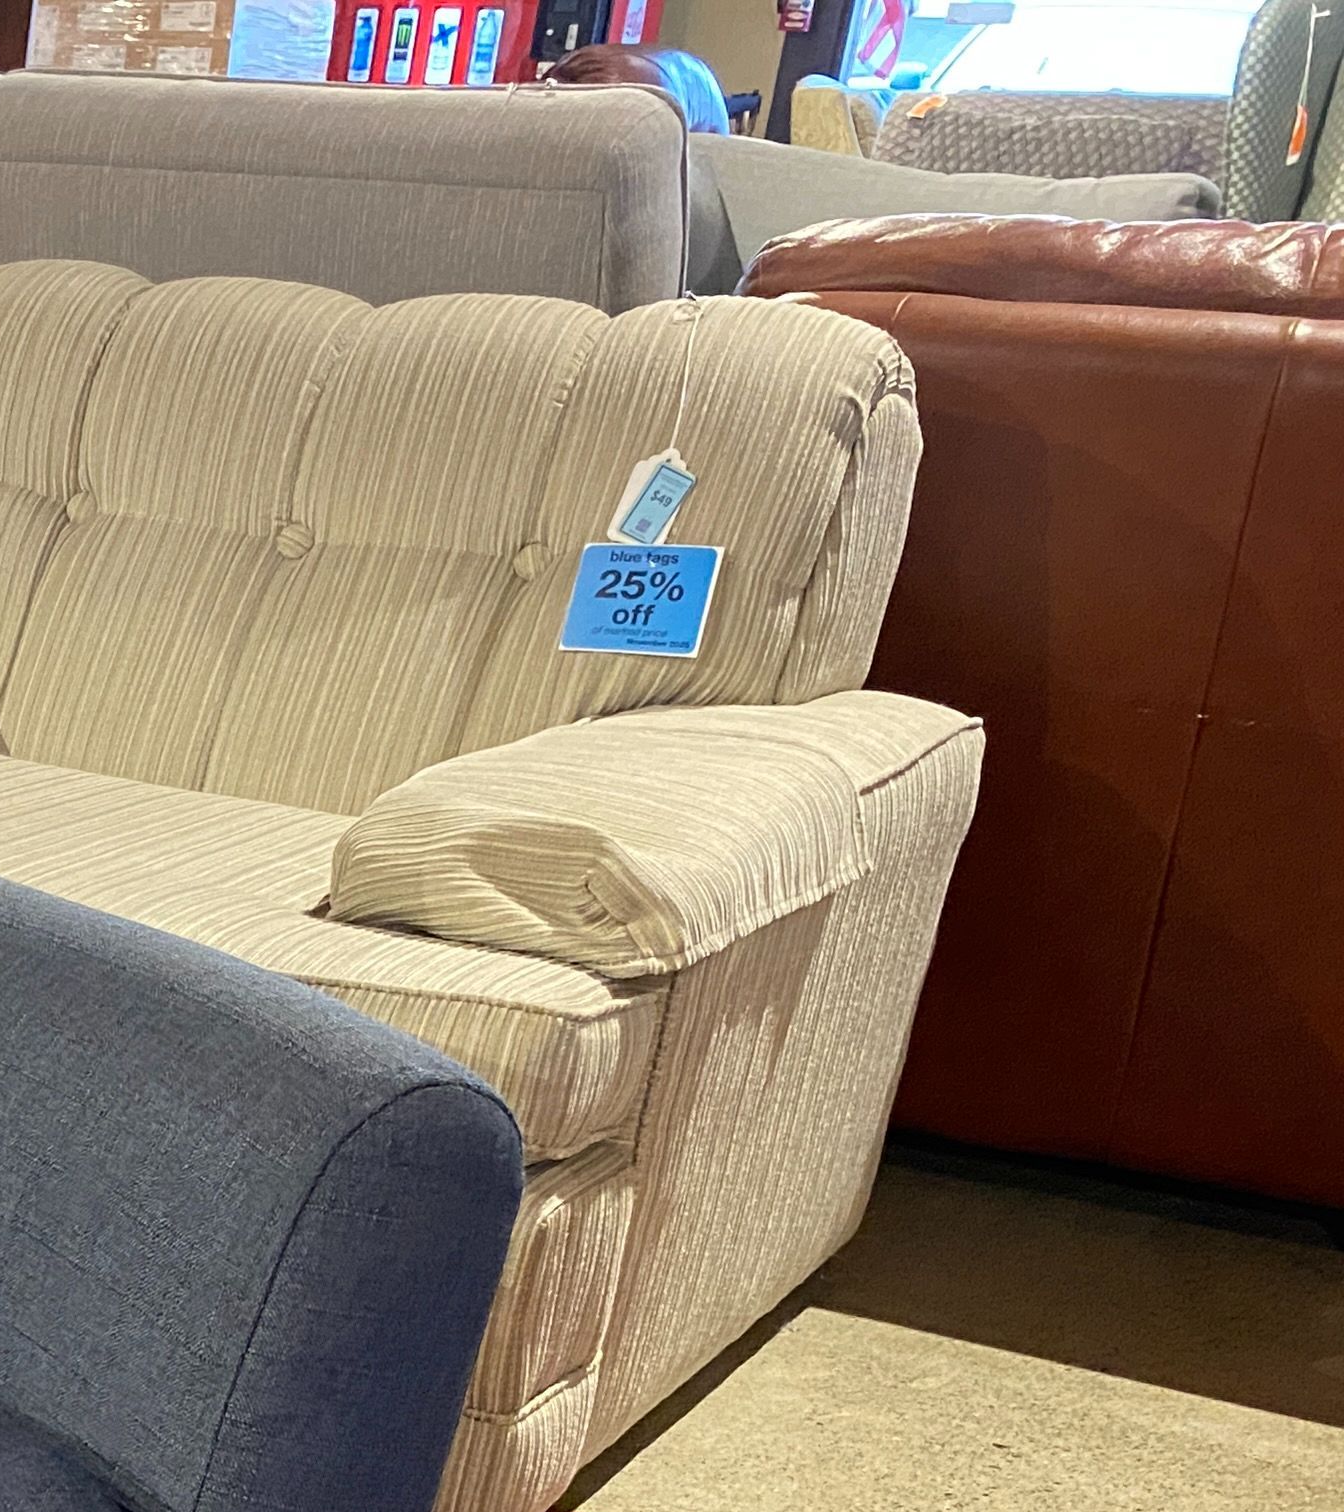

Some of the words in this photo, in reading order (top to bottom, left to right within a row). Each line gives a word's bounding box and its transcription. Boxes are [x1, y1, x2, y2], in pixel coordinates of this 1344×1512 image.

[650, 490, 673, 508] $49
[610, 551, 642, 563] blue
[646, 551, 680, 566] tags
[594, 569, 685, 602] 25%
[612, 604, 656, 626] off
